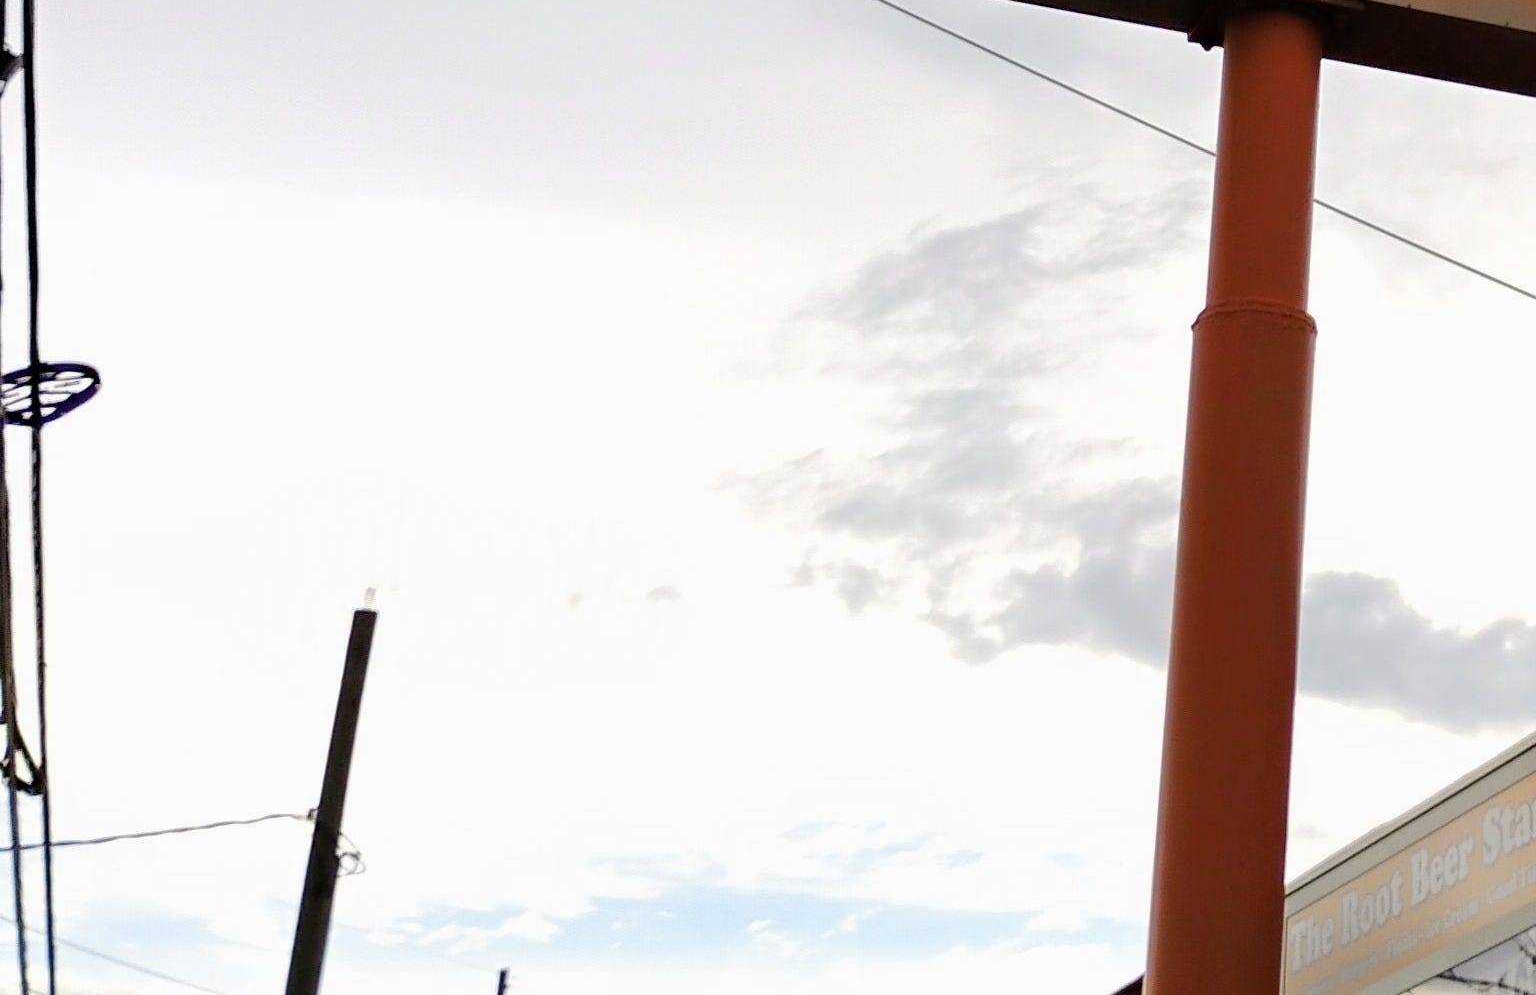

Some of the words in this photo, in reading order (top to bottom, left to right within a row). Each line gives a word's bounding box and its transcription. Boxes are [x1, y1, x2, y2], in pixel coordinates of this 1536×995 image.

[1290, 914, 1336, 973] The
[1340, 870, 1404, 948] Root
[1409, 834, 1475, 908] Beer
